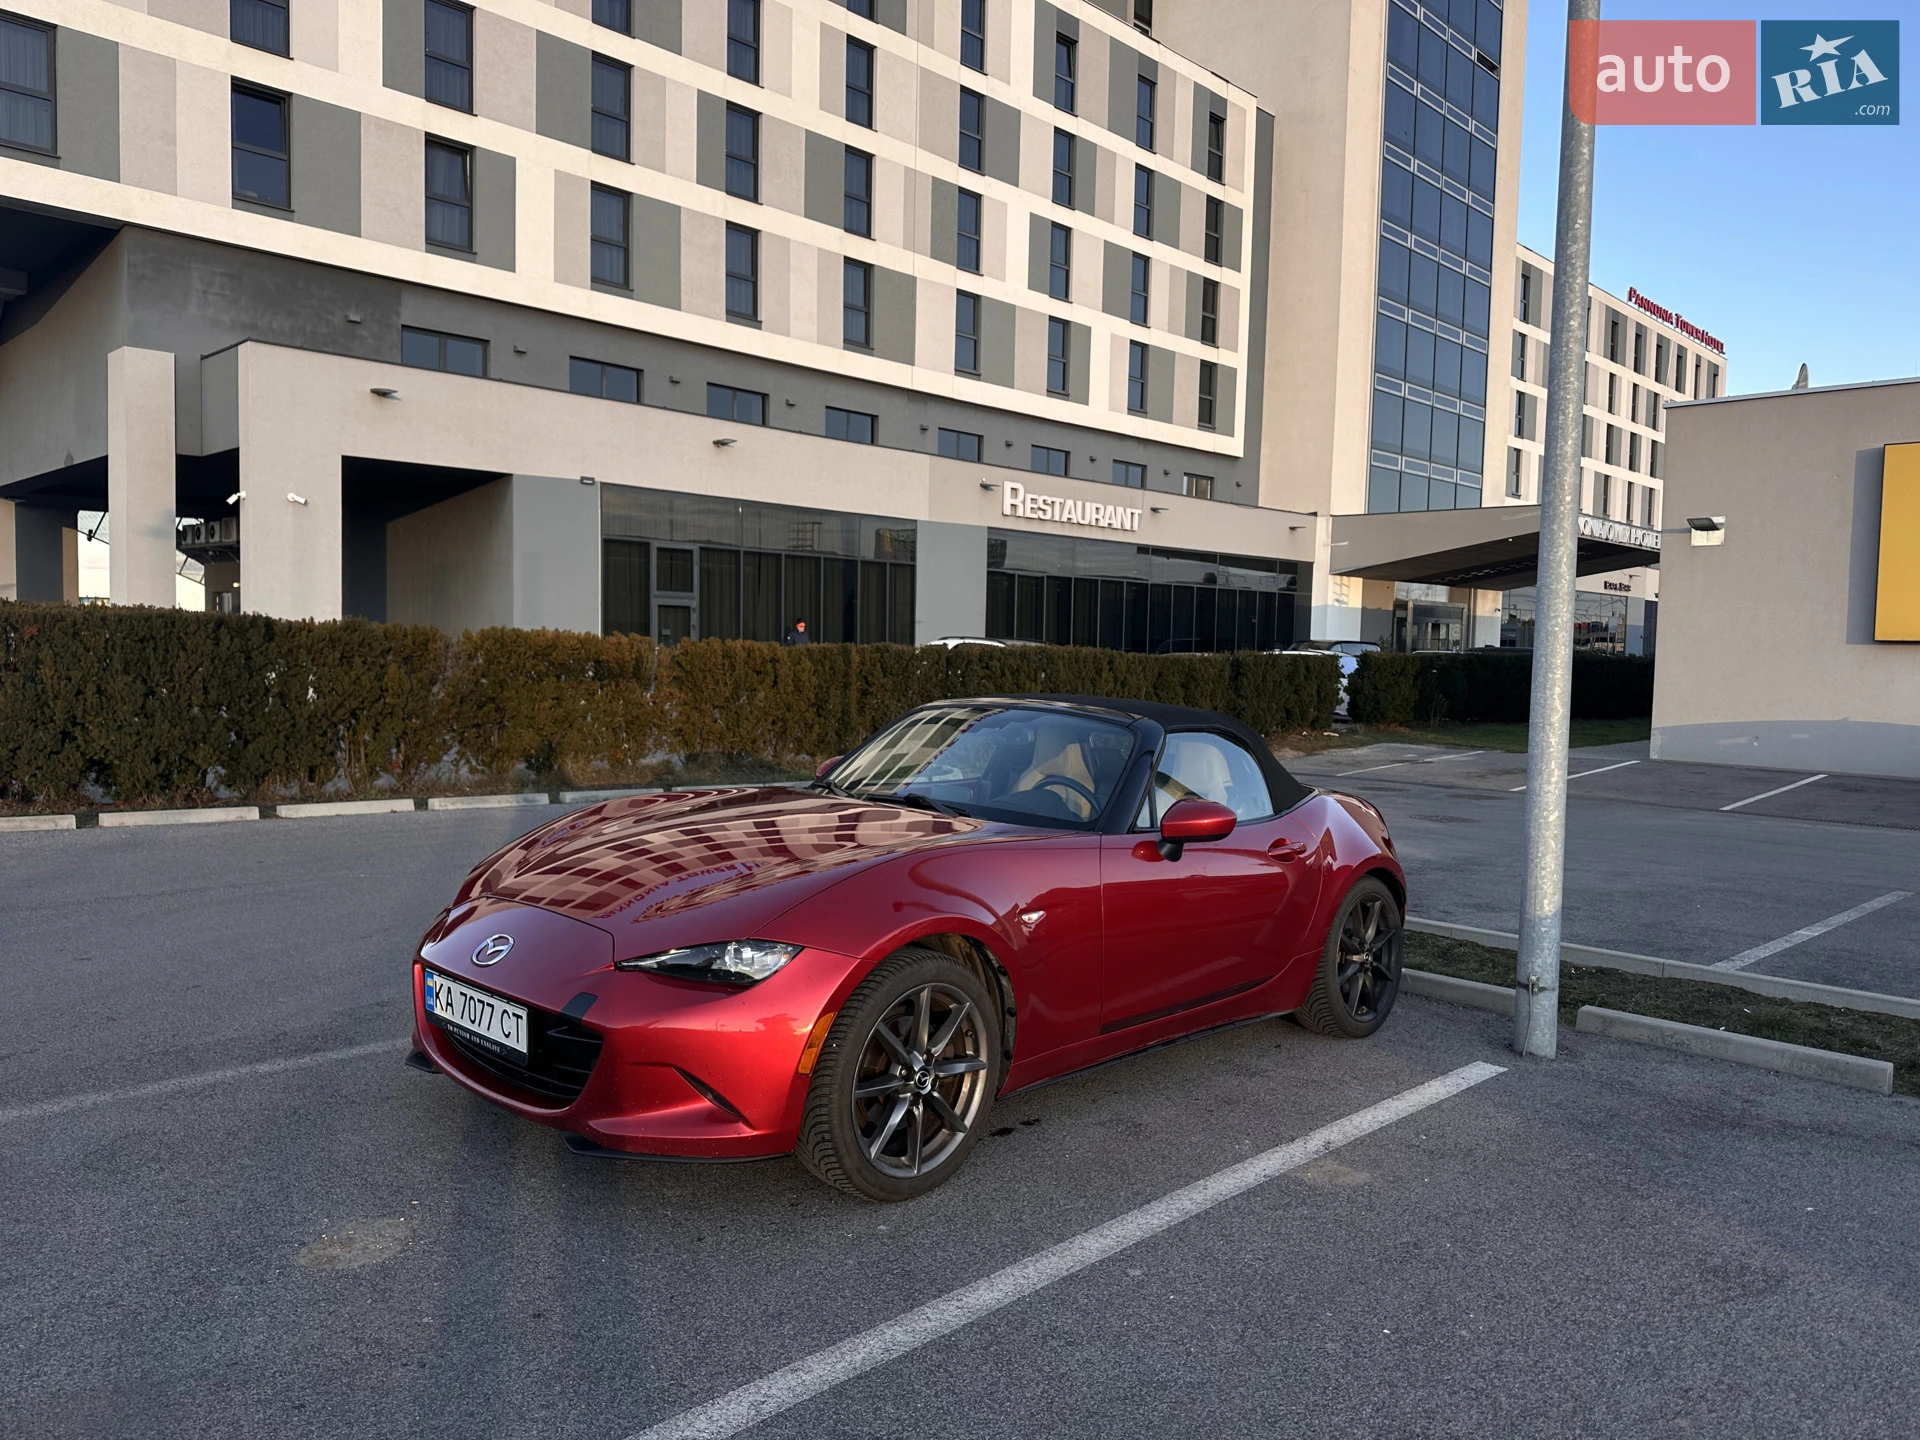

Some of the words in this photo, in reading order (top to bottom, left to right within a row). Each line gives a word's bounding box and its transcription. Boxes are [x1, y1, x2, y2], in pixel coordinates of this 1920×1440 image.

[1003, 481, 1142, 531] RESTAURANT
[434, 980, 455, 1016] KA
[459, 991, 495, 1032] 7077
[500, 1009, 523, 1044] CT
